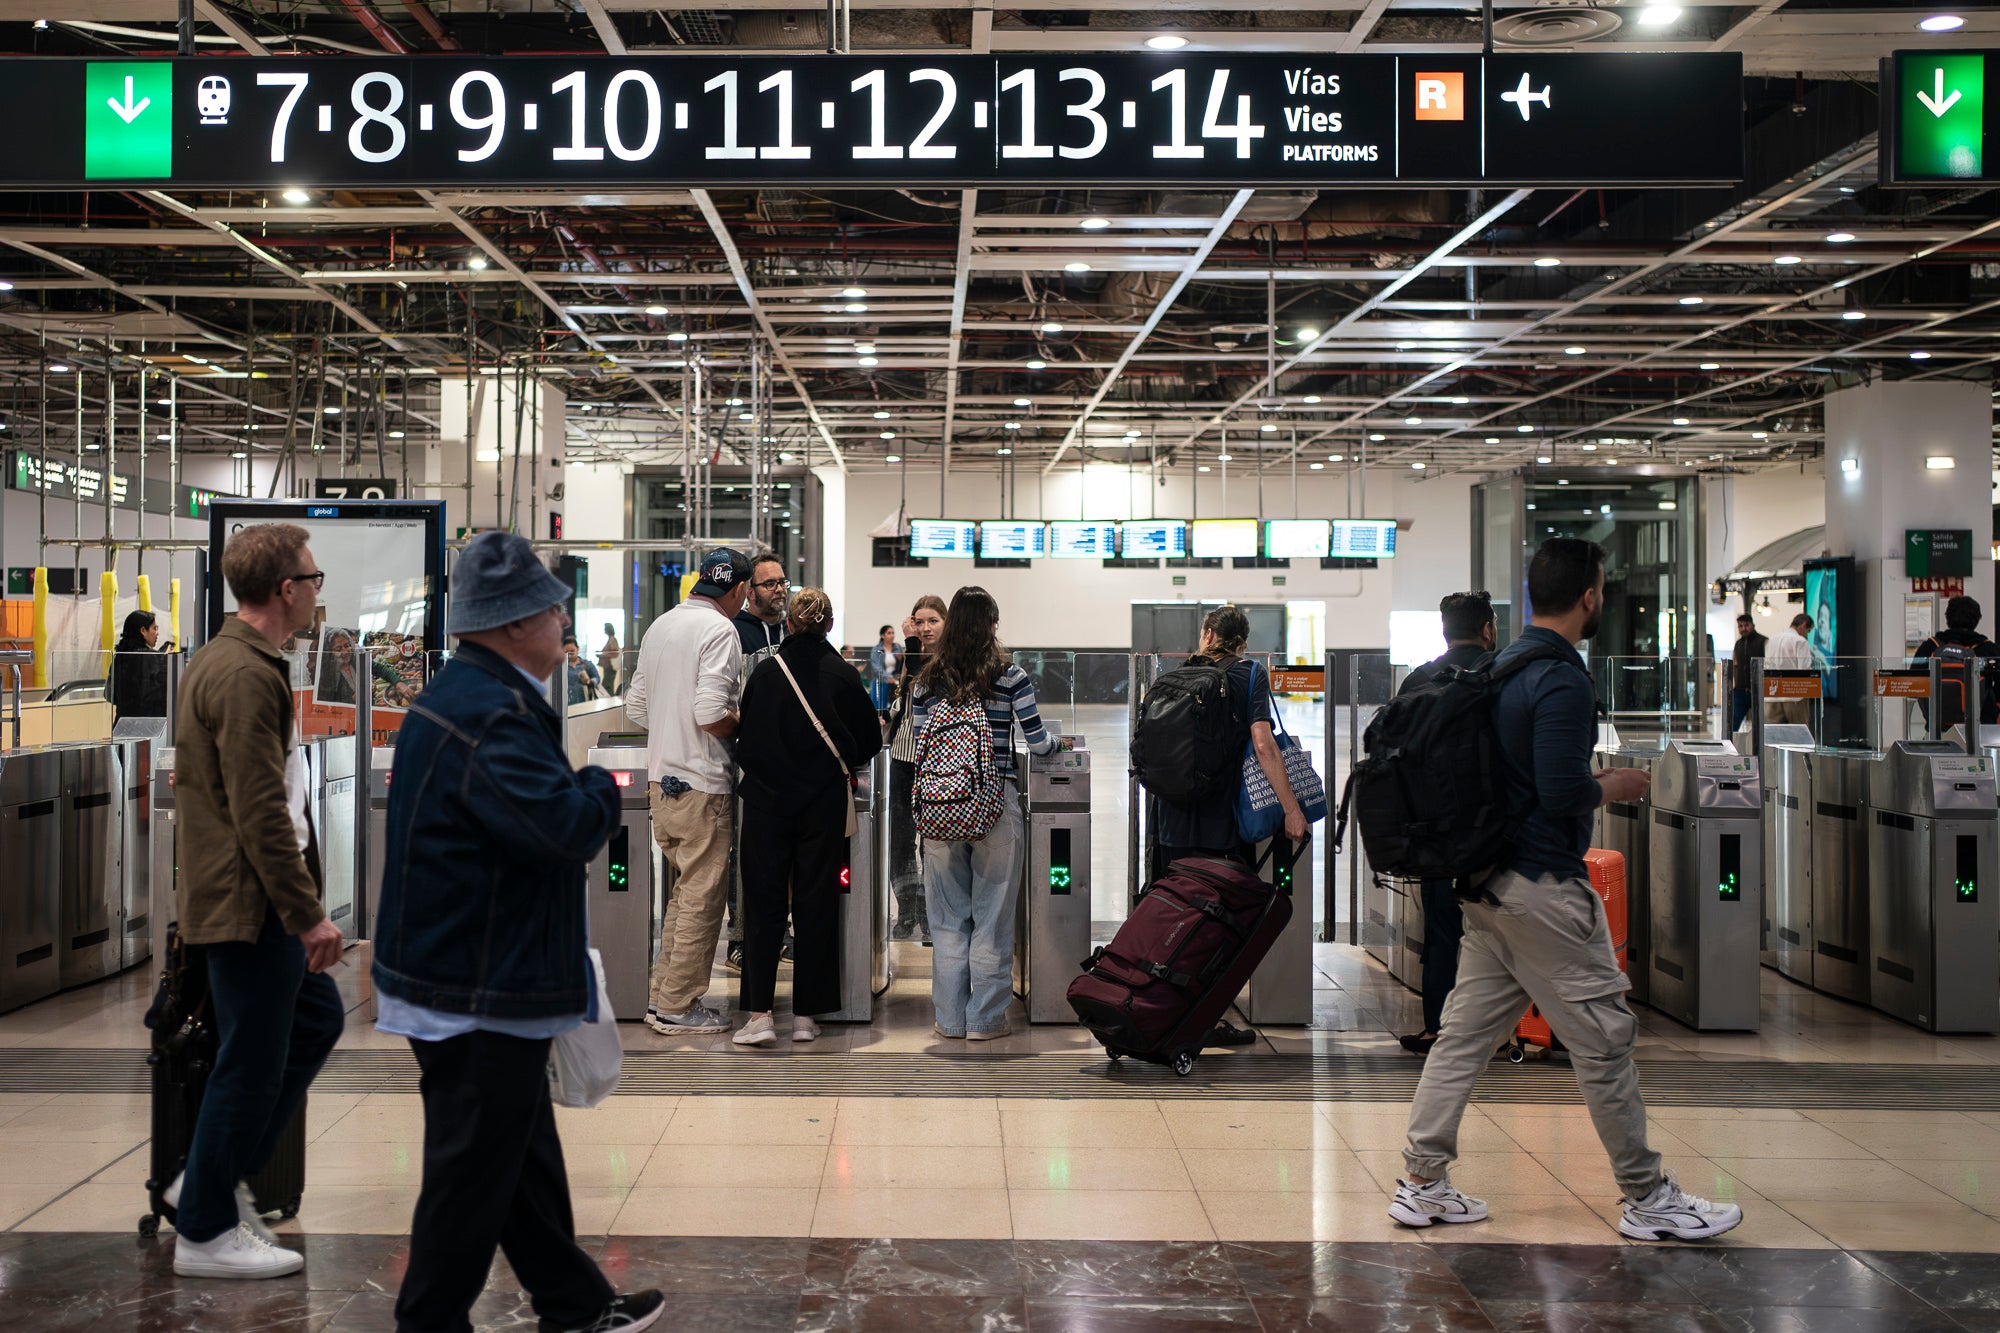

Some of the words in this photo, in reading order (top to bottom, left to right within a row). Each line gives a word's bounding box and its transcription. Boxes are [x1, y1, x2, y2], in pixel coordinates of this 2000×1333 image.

[1284, 67, 1341, 95] Vías
[1418, 80, 1447, 109] R
[257, 73, 308, 162] 7
[349, 72, 405, 162] 8
[450, 71, 505, 162] 9
[552, 70, 661, 161] 10
[704, 70, 811, 159] 11
[851, 70, 956, 159] 12
[1002, 68, 1107, 159] 13
[1152, 69, 1265, 158] 14
[1284, 105, 1342, 132] Vies
[1283, 145, 1379, 162] PLATFORMS
[314, 508, 332, 516] global
